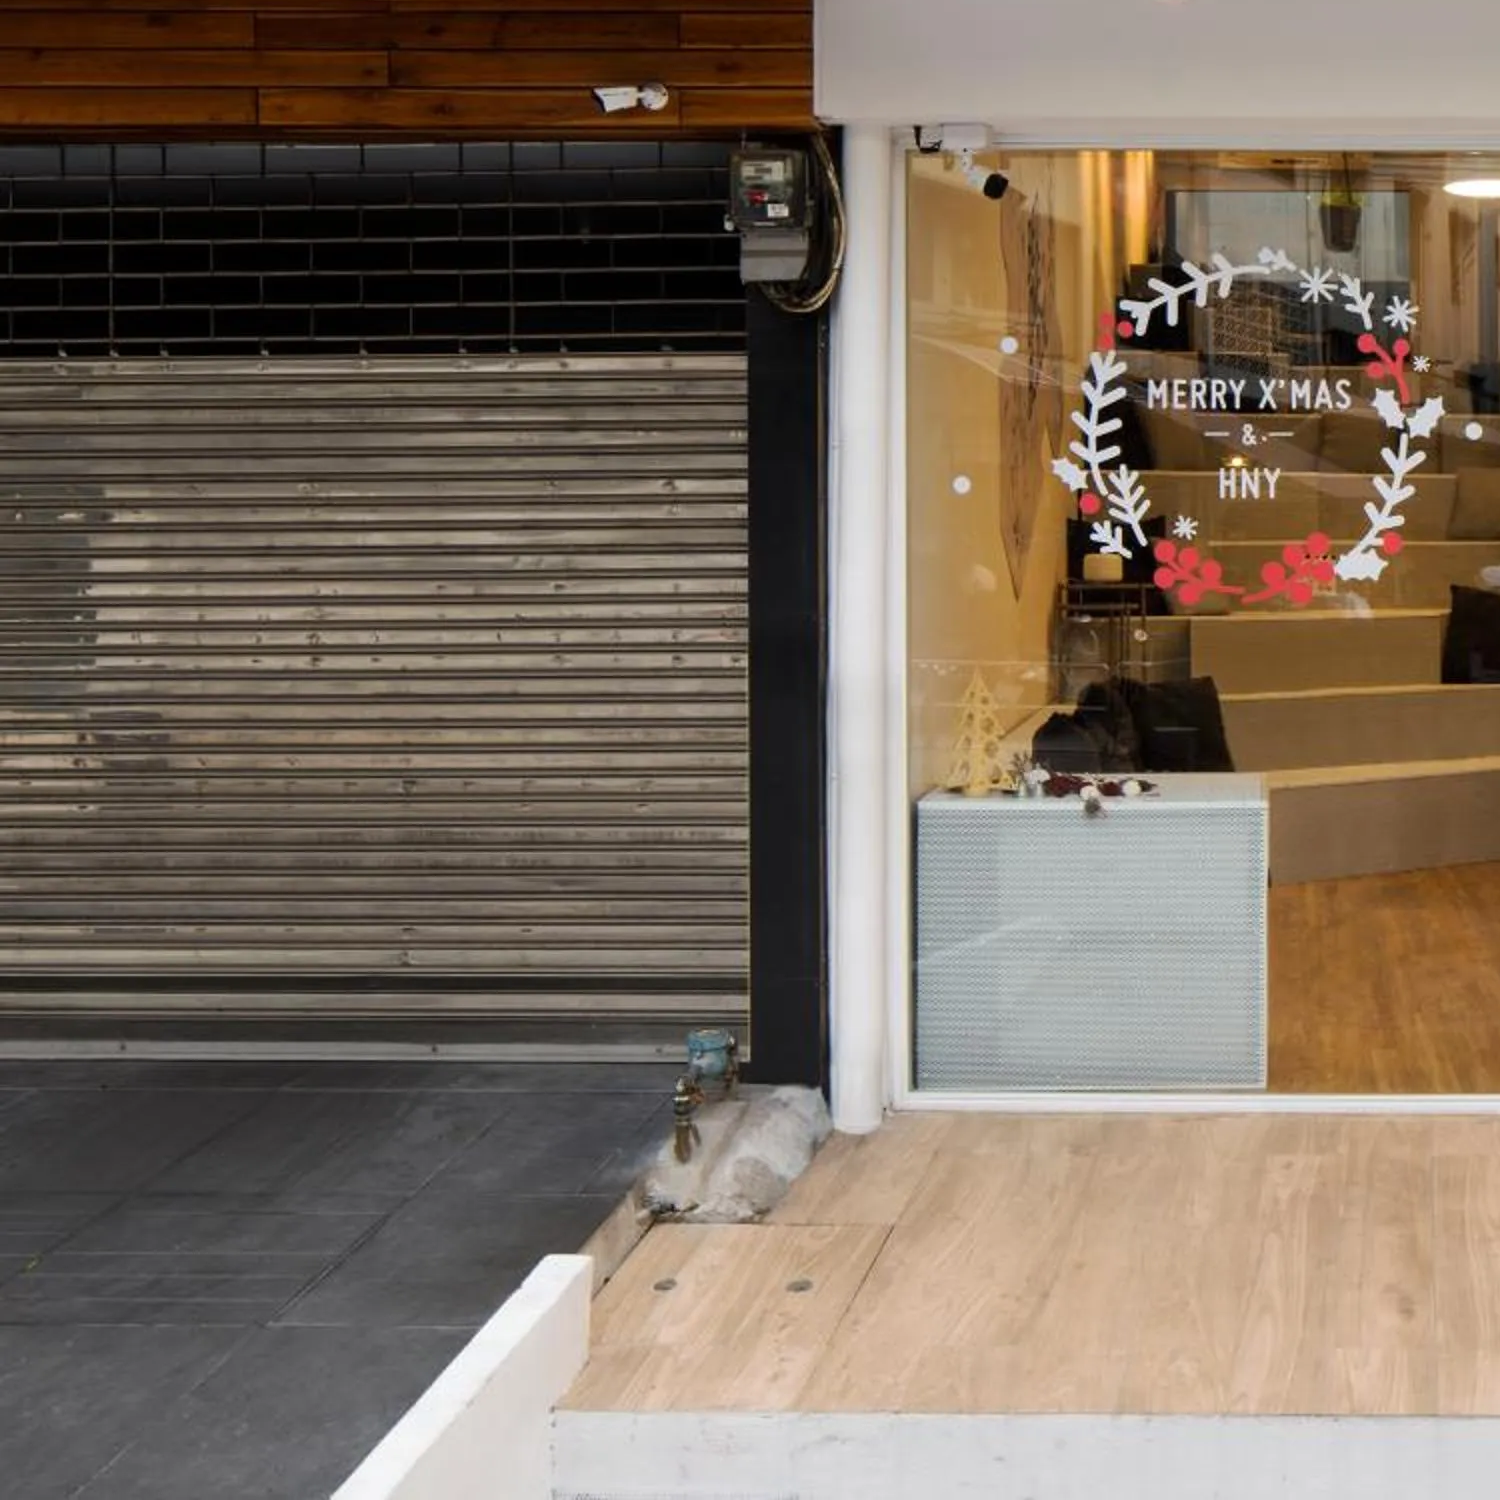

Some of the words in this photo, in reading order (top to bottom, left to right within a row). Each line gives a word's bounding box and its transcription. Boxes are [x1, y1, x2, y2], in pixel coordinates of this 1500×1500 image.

[1147, 379, 1246, 410] MERRY
[1258, 378, 1352, 411] X'MAS
[1218, 467, 1281, 500] HNY
